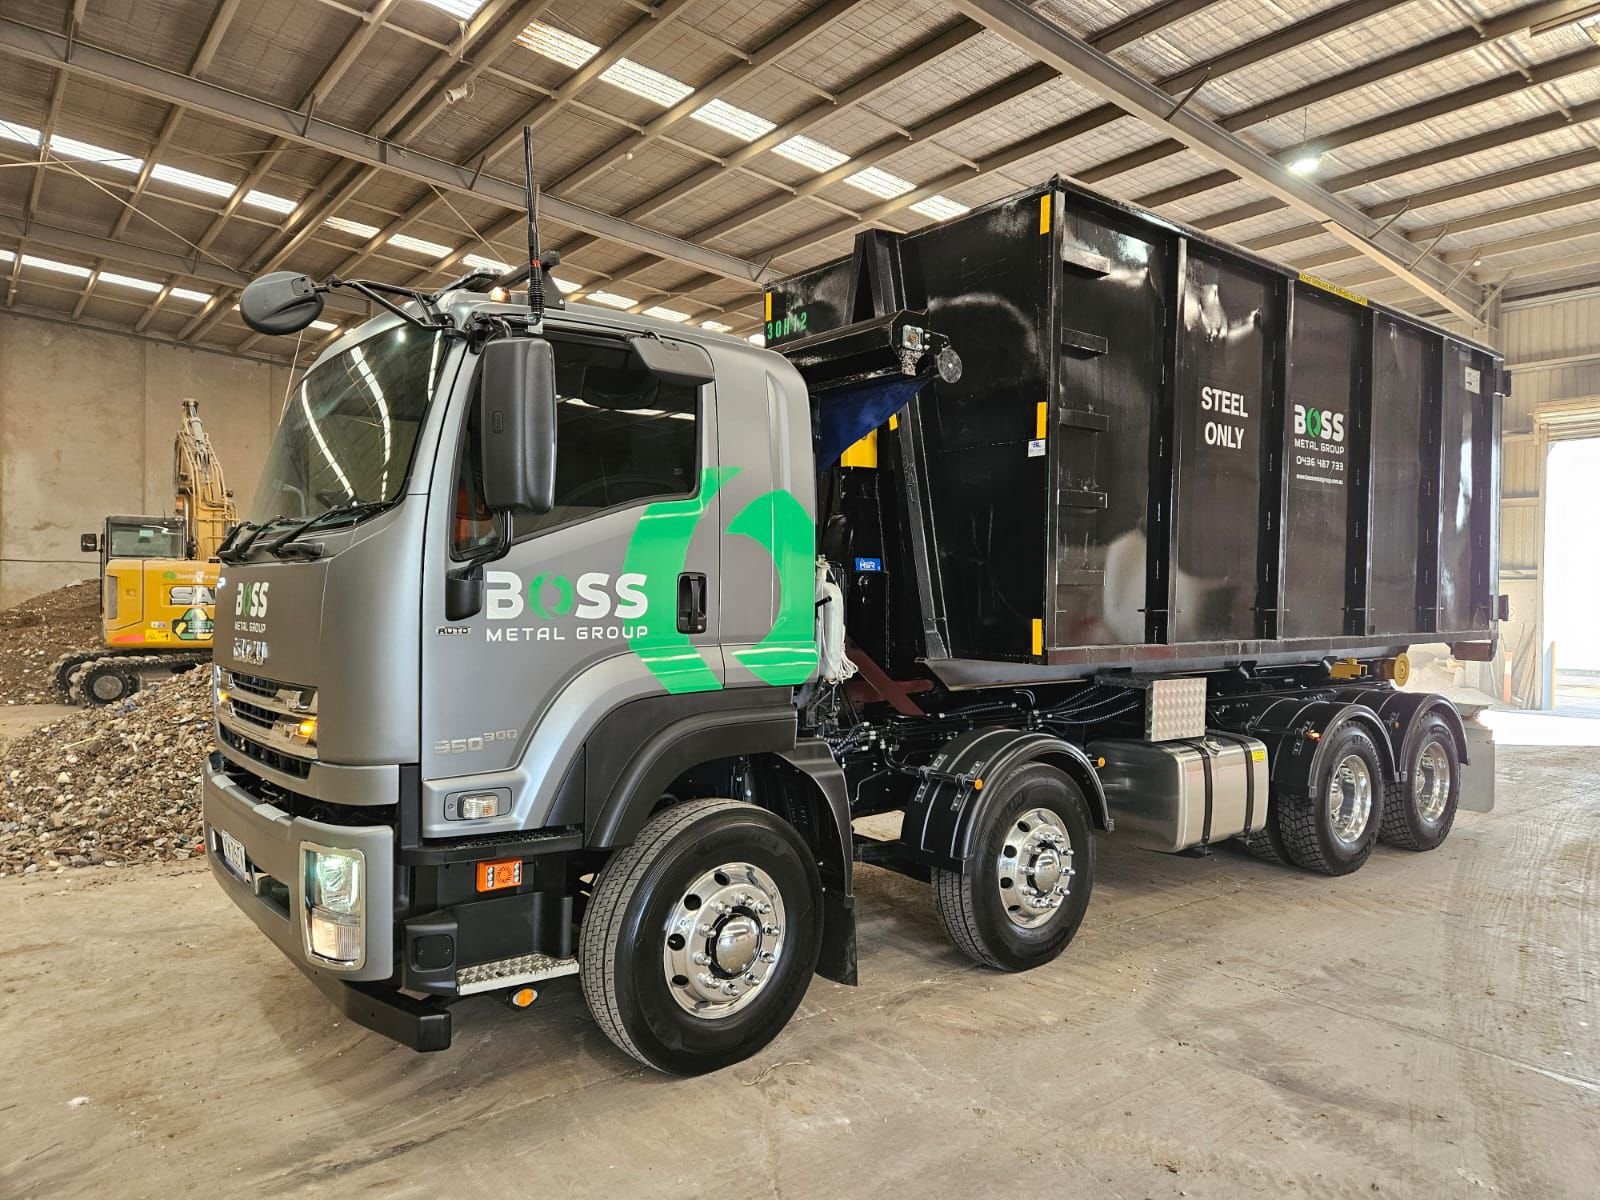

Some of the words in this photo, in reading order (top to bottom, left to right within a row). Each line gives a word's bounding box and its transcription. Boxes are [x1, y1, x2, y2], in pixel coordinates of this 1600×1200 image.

[1201, 386, 1249, 418] STEEL
[1294, 404, 1345, 442] BOSS
[1204, 421, 1245, 449] ONLY
[1294, 438, 1319, 451] METAL
[1320, 442, 1345, 455] GROUP
[1296, 455, 1316, 467] 0436
[169, 586, 216, 606] SA
[235, 582, 270, 618] BOSS
[485, 571, 648, 620] BOSS
[234, 620, 249, 632] METAL
[249, 621, 266, 634] GROUP
[438, 626, 471, 636] AUTO
[486, 627, 565, 642] METAL
[576, 625, 648, 640] GROUP
